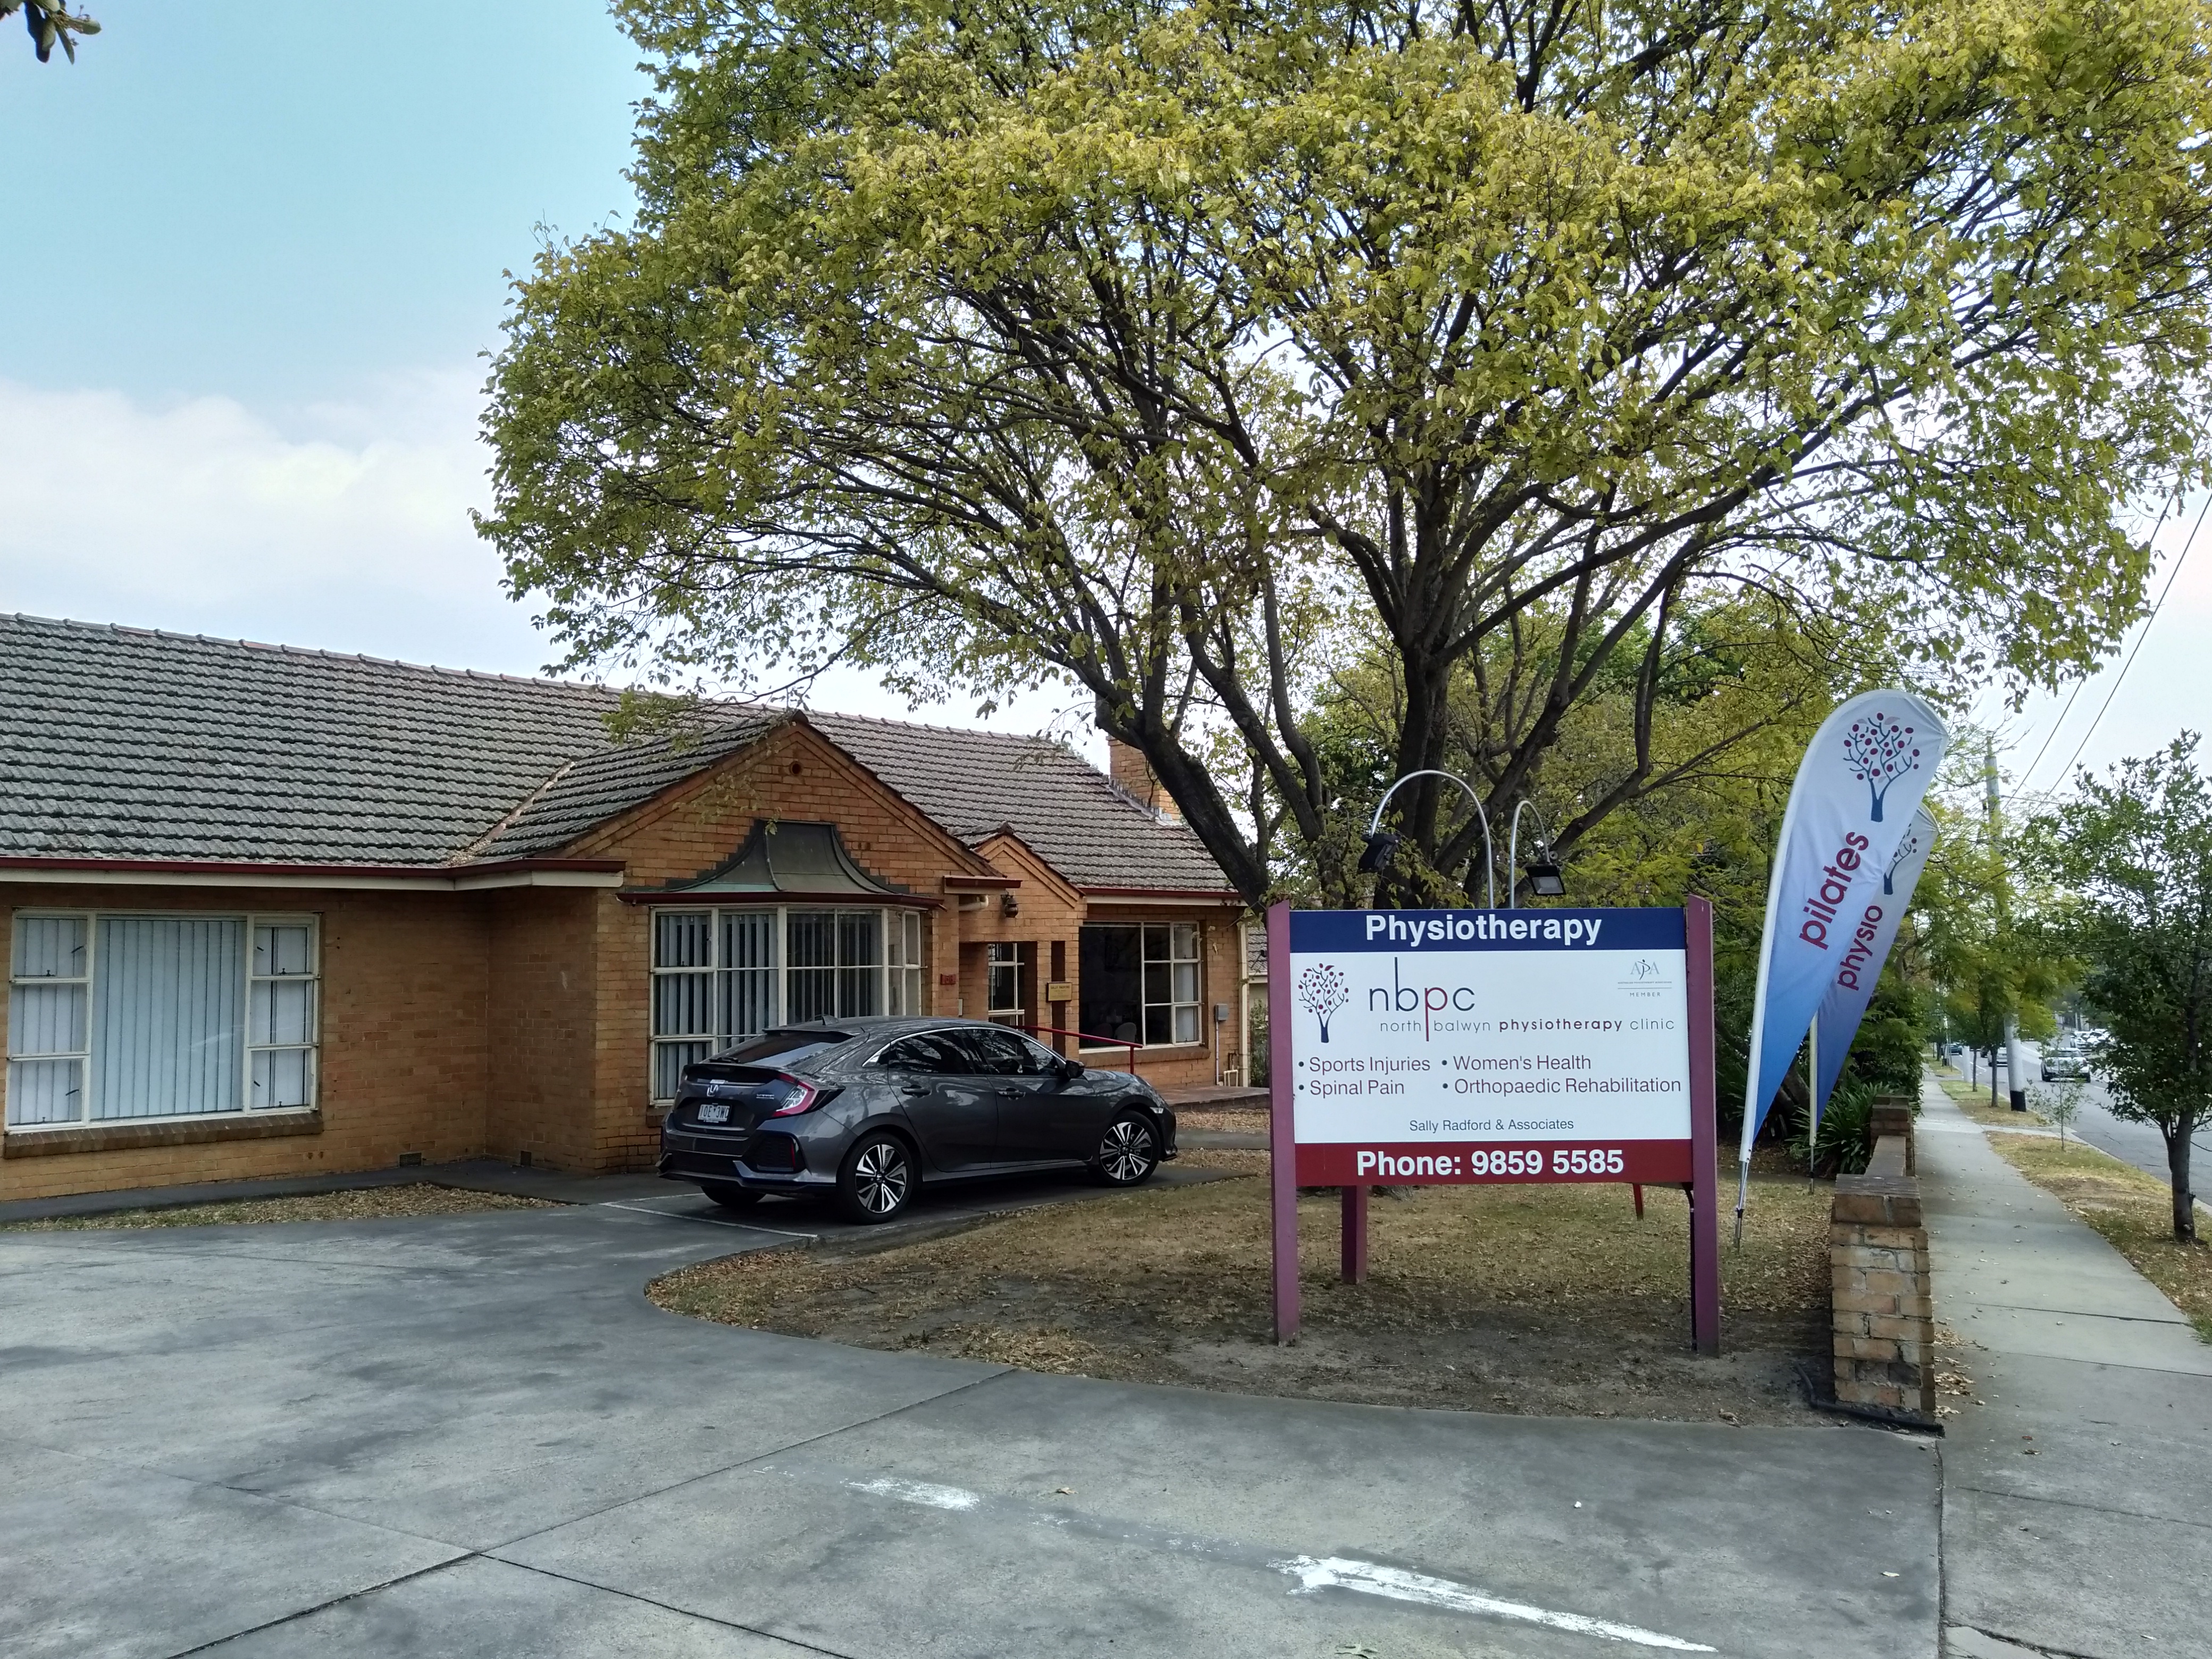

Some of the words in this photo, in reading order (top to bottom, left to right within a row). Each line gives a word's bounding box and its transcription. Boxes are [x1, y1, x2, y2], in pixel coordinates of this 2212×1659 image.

[1799, 832, 1869, 950] pilates
[1366, 914, 1602, 947] Physiotherapy
[1837, 905, 1883, 991] physio
[1630, 959, 1660, 981] APA
[1369, 957, 1475, 1042] nbpc
[1380, 1020, 1421, 1032] north
[1434, 1020, 1490, 1034] balwyn
[1499, 1018, 1623, 1033] physiotherapy
[1630, 1018, 1674, 1030] clinic
[1309, 1057, 1364, 1076] Sports
[1369, 1056, 1430, 1075] Injuries
[1453, 1055, 1532, 1071] Women's
[1537, 1054, 1591, 1070] Health
[1310, 1079, 1362, 1099] Spinal
[1368, 1079, 1404, 1095] Pain
[1454, 1078, 1561, 1097] Orthopaedic
[1565, 1076, 1681, 1093] Rehabilitation
[1410, 1120, 1439, 1134] Sally
[1443, 1119, 1491, 1131] Radford
[1495, 1119, 1504, 1130] &
[1508, 1119, 1574, 1130] Associates
[1357, 1150, 1462, 1177] Phone:
[1471, 1150, 1543, 1175] 9859
[1553, 1149, 1624, 1174] 5585
